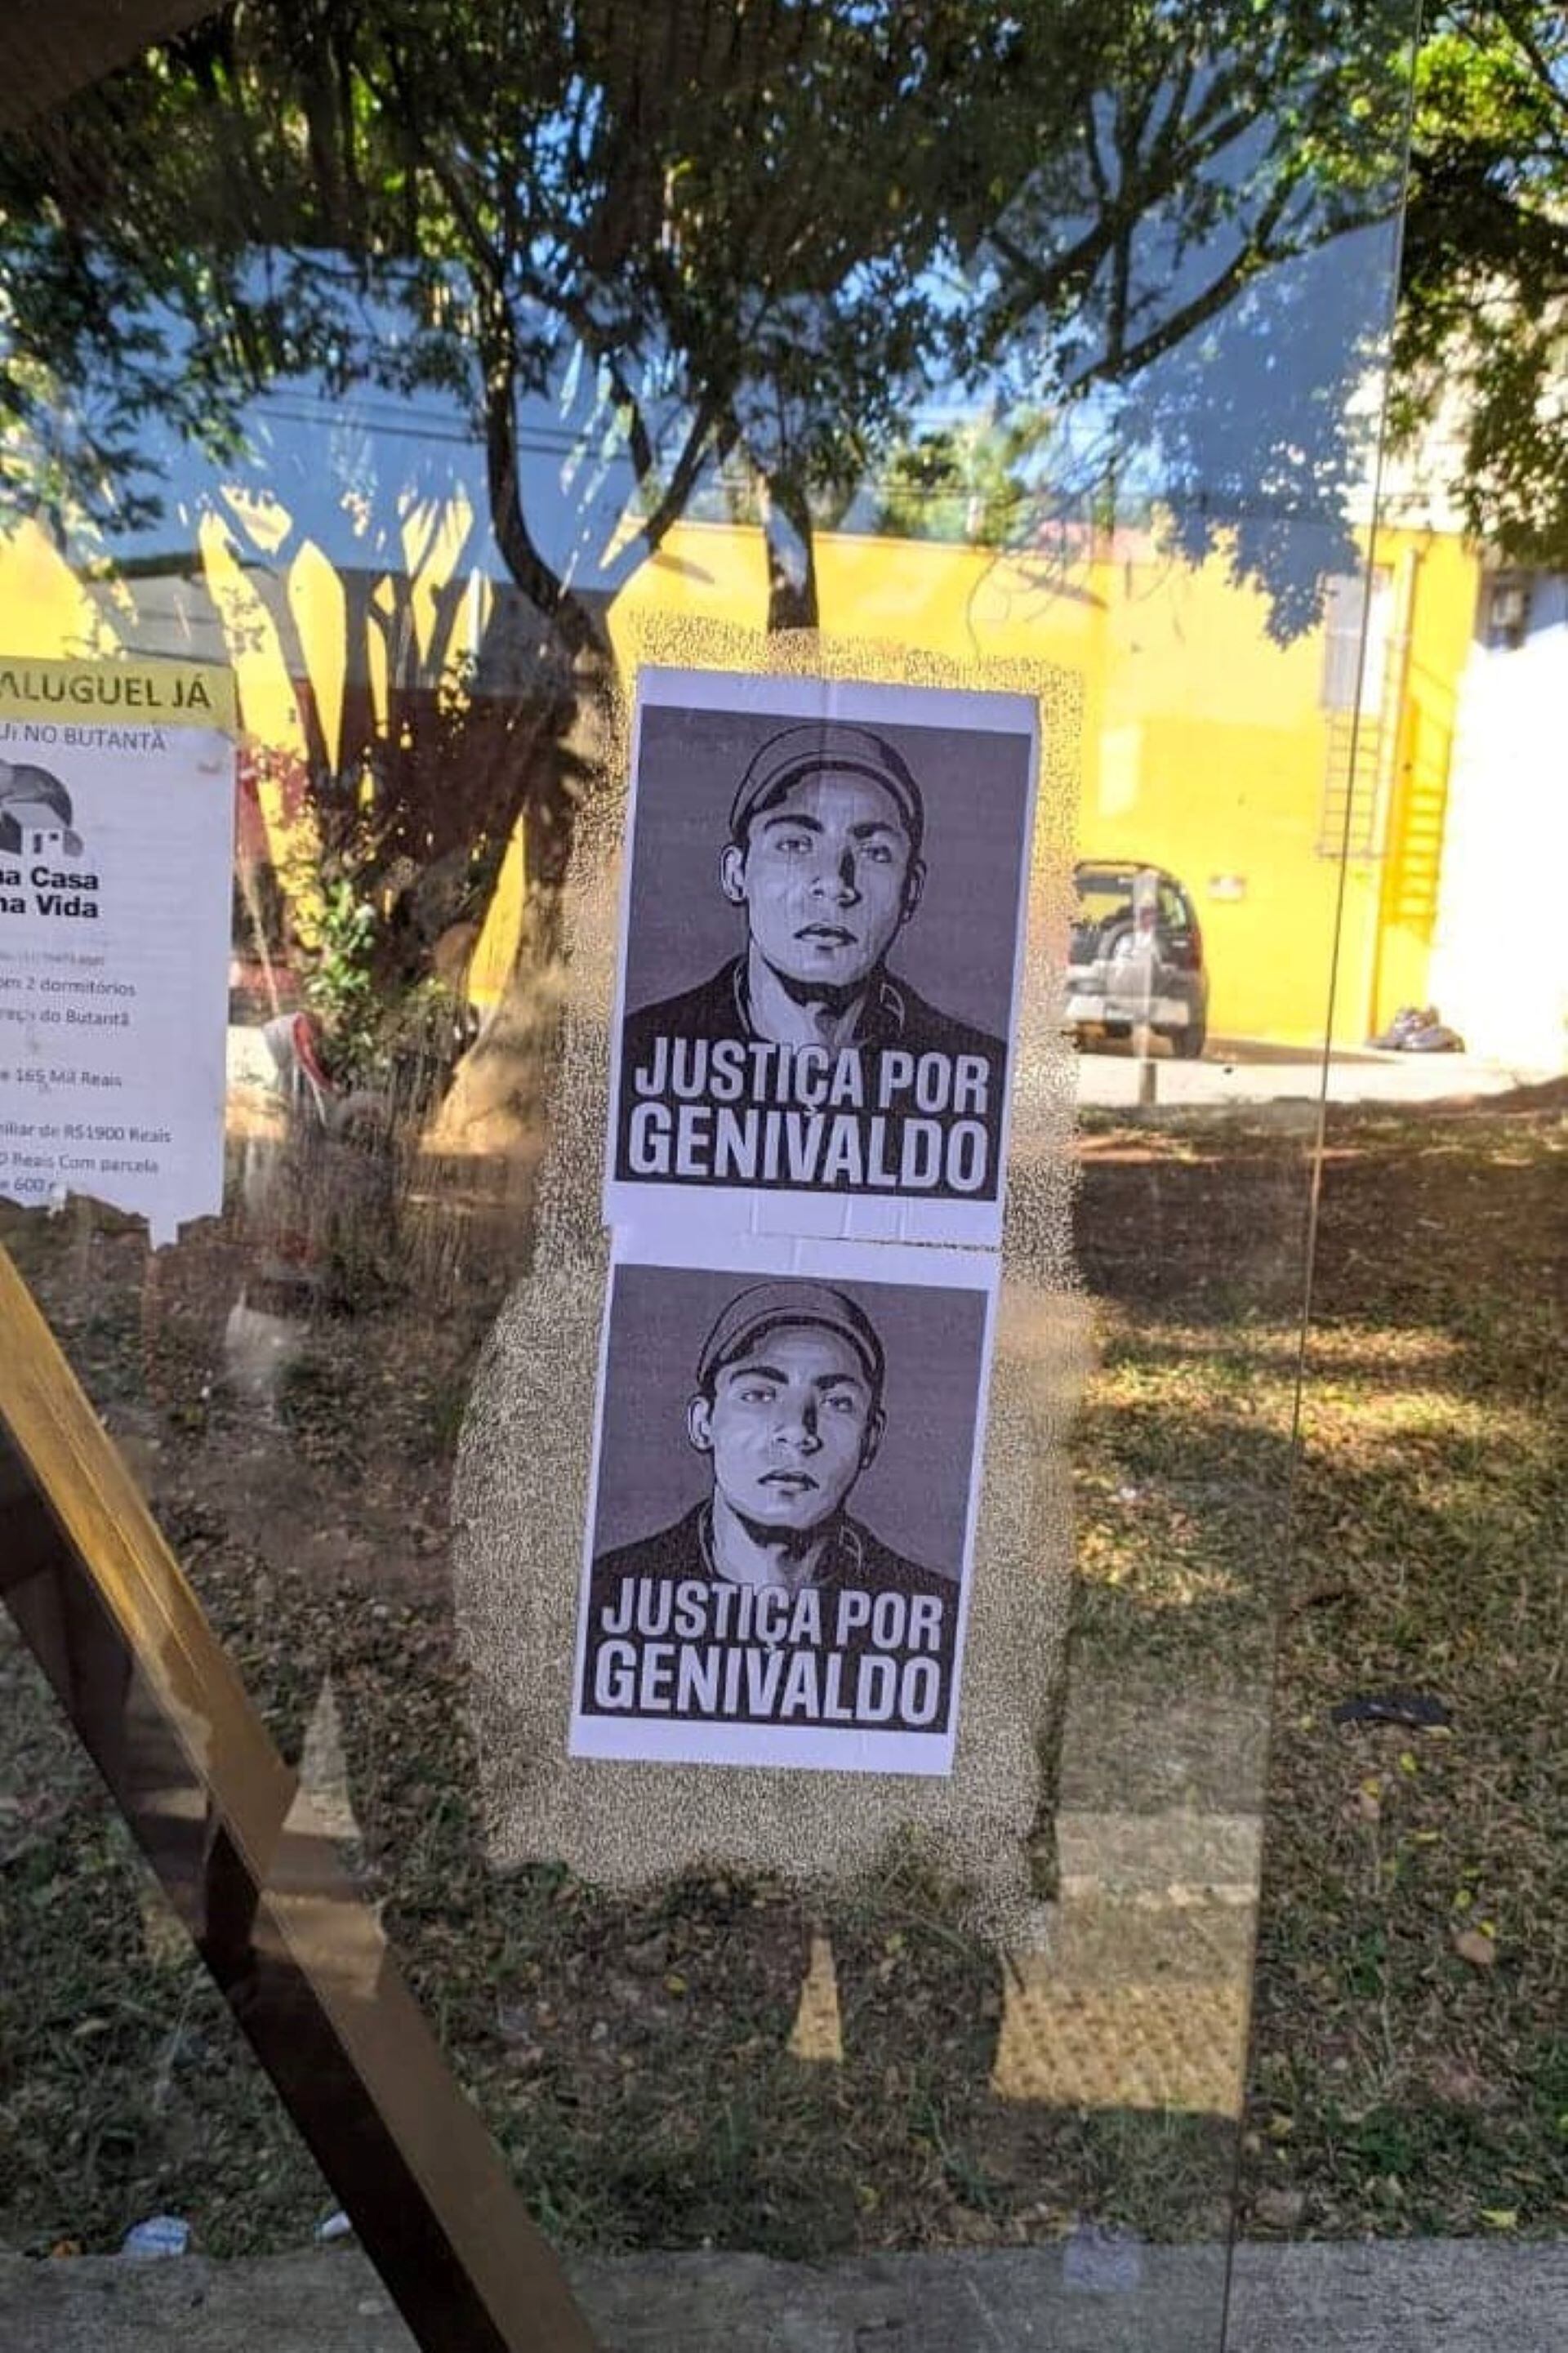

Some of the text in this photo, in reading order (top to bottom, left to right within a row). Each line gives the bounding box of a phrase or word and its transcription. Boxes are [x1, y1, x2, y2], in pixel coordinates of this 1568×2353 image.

[0, 671, 212, 709] ALUGUEL JÁ
[24, 724, 57, 744] NO
[64, 726, 167, 751] BUTANTÃ
[31, 866, 99, 890] Casa
[36, 894, 99, 918] Vida
[26, 977, 35, 990] 2
[41, 979, 136, 997] dormitórios
[66, 1009, 130, 1026] Butantã
[81, 1071, 122, 1088] Reais
[635, 1036, 990, 1116] JUSTIÇA POR
[129, 1126, 173, 1143] Reais
[628, 1102, 988, 1192] GENIVALDO
[59, 1154, 96, 1170] Com
[101, 1158, 159, 1173] parcela
[602, 1578, 943, 1655] JUSTIÇA POR
[595, 1640, 941, 1725] GENIVALDO
